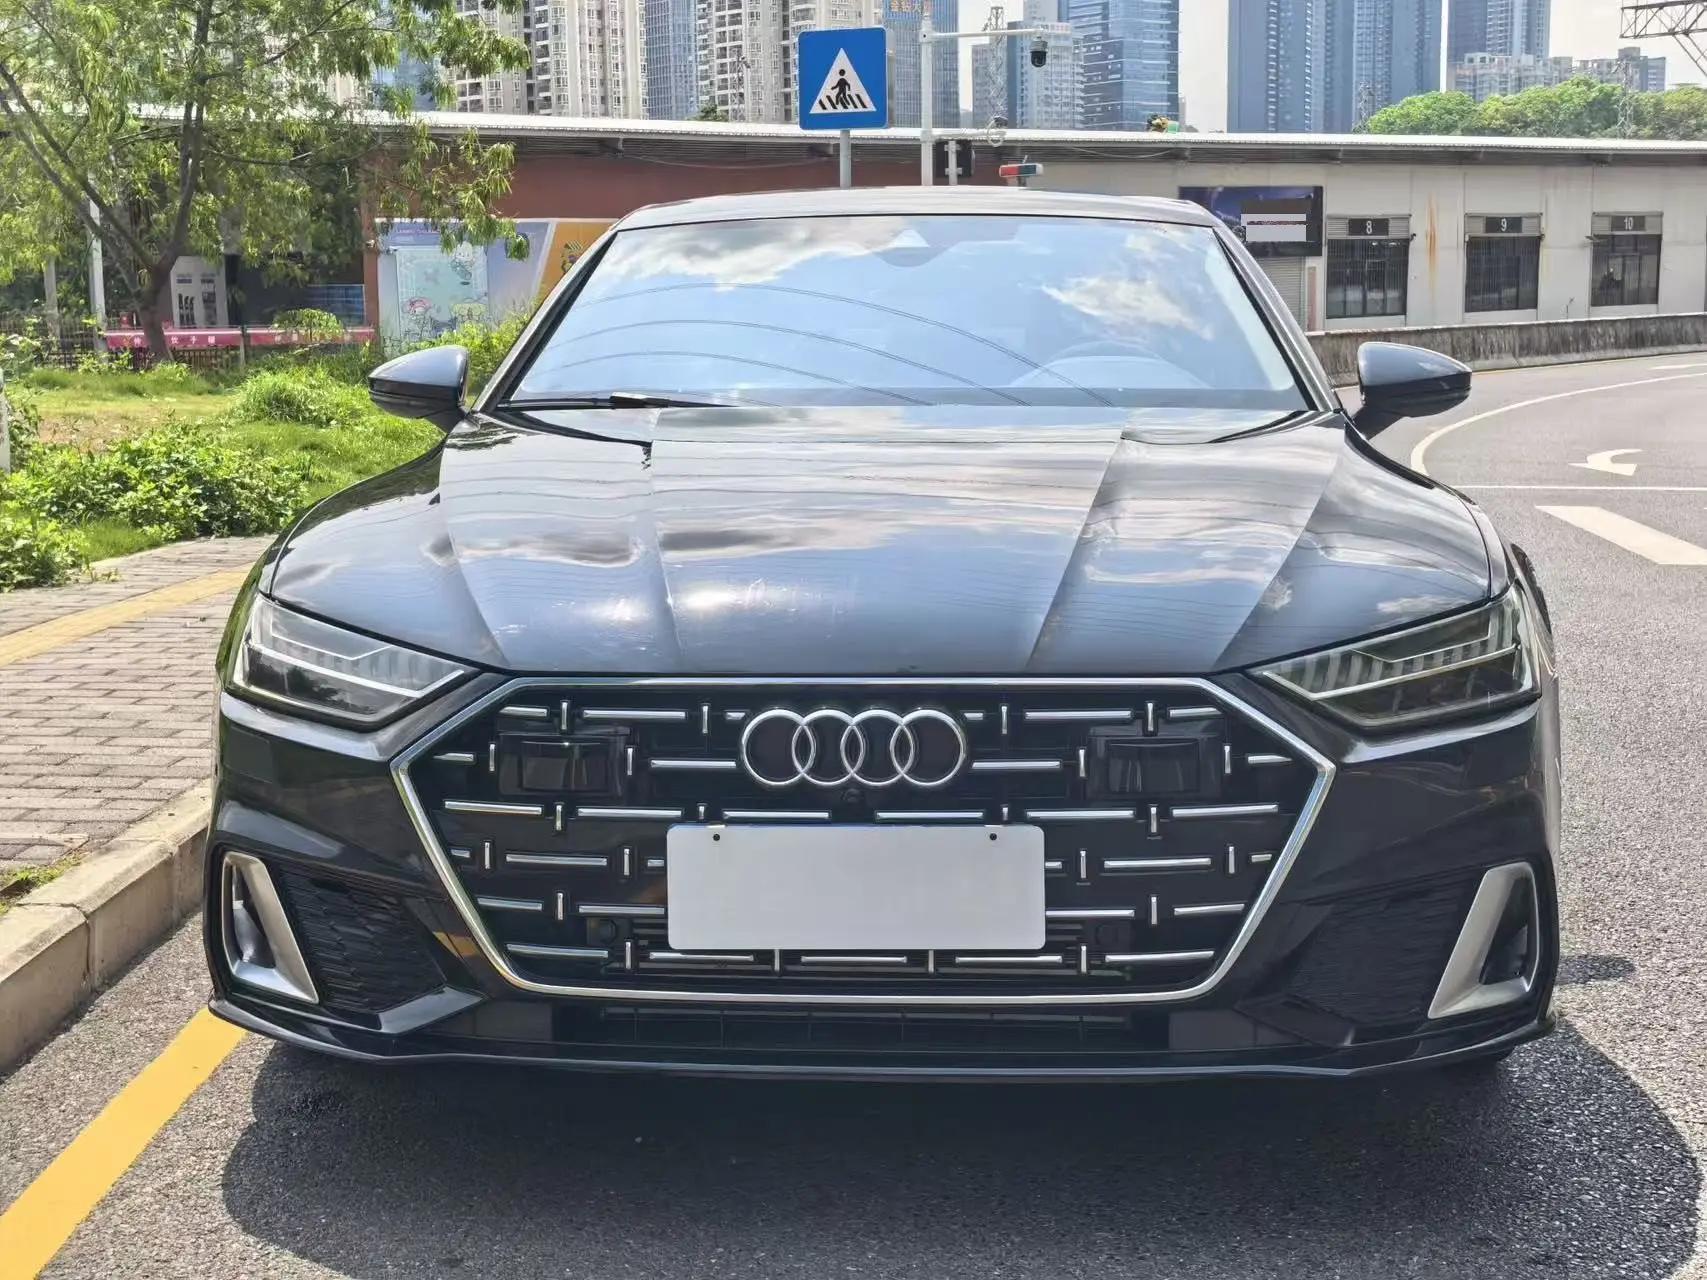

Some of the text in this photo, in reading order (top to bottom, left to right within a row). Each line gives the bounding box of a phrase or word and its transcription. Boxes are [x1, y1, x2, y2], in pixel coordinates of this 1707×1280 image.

[1365, 220, 1374, 235] 8
[1500, 217, 1508, 232] 9
[1623, 216, 1634, 231] 10
